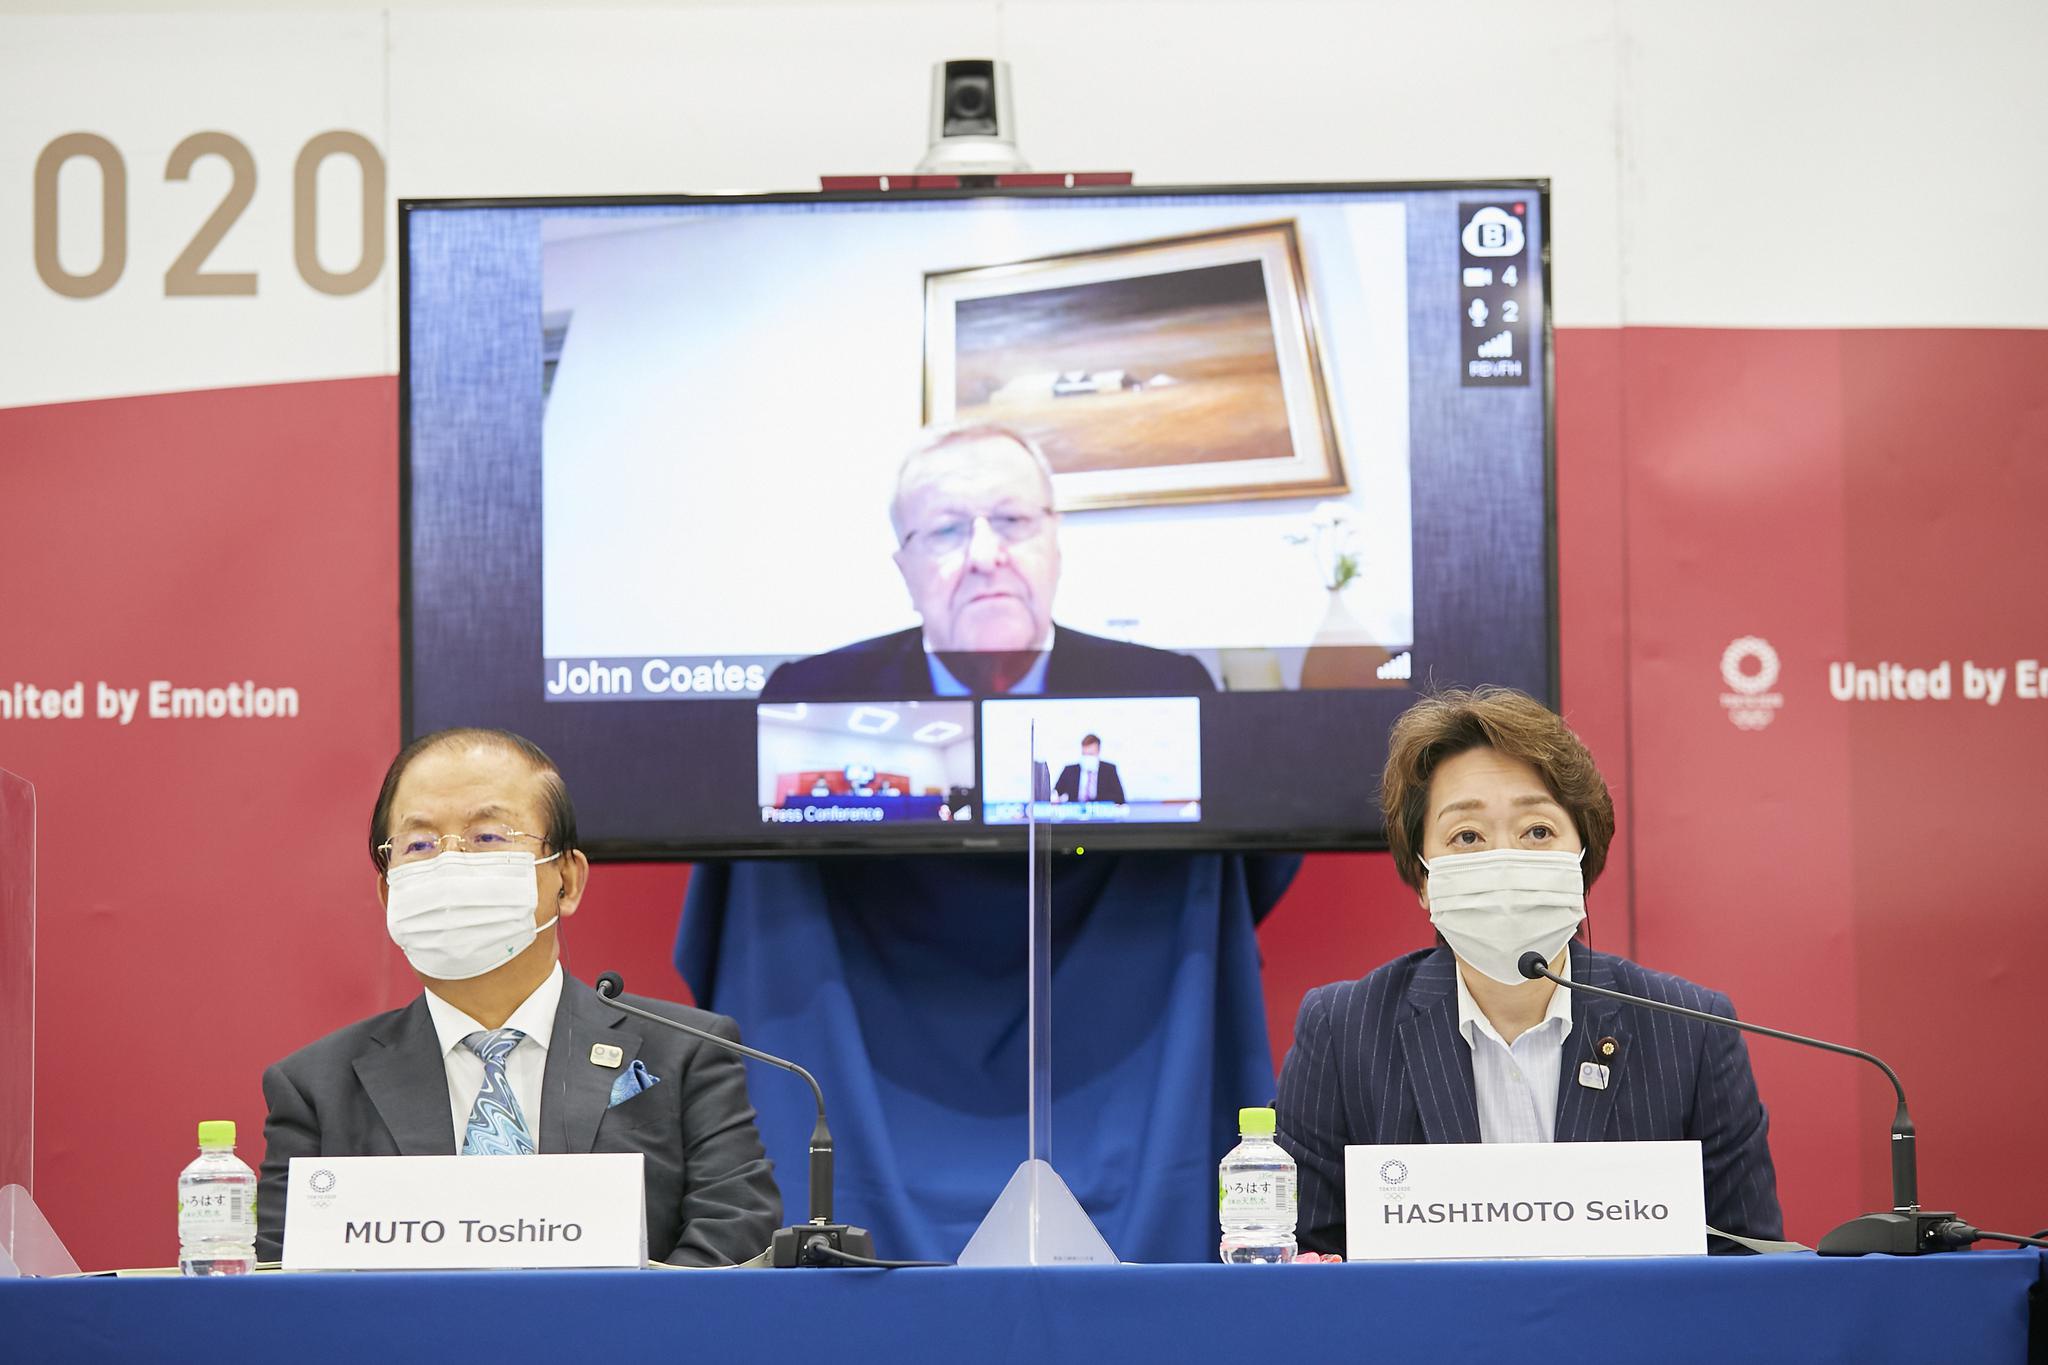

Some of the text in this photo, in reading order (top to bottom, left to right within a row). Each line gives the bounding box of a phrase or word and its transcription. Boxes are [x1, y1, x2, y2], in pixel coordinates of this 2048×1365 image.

[34, 130, 387, 299] 020
[1501, 264, 1519, 288] 4
[1502, 300, 1519, 323] 2
[547, 658, 766, 695] John Coates
[1829, 659, 2048, 706] United by E
[97, 681, 140, 725] by
[149, 680, 299, 719] Emotion
[761, 804, 884, 822] Press Conference
[1383, 1199, 1669, 1224] HASHIMOTO Seiko
[344, 1218, 583, 1244] MUTO Toshiro
